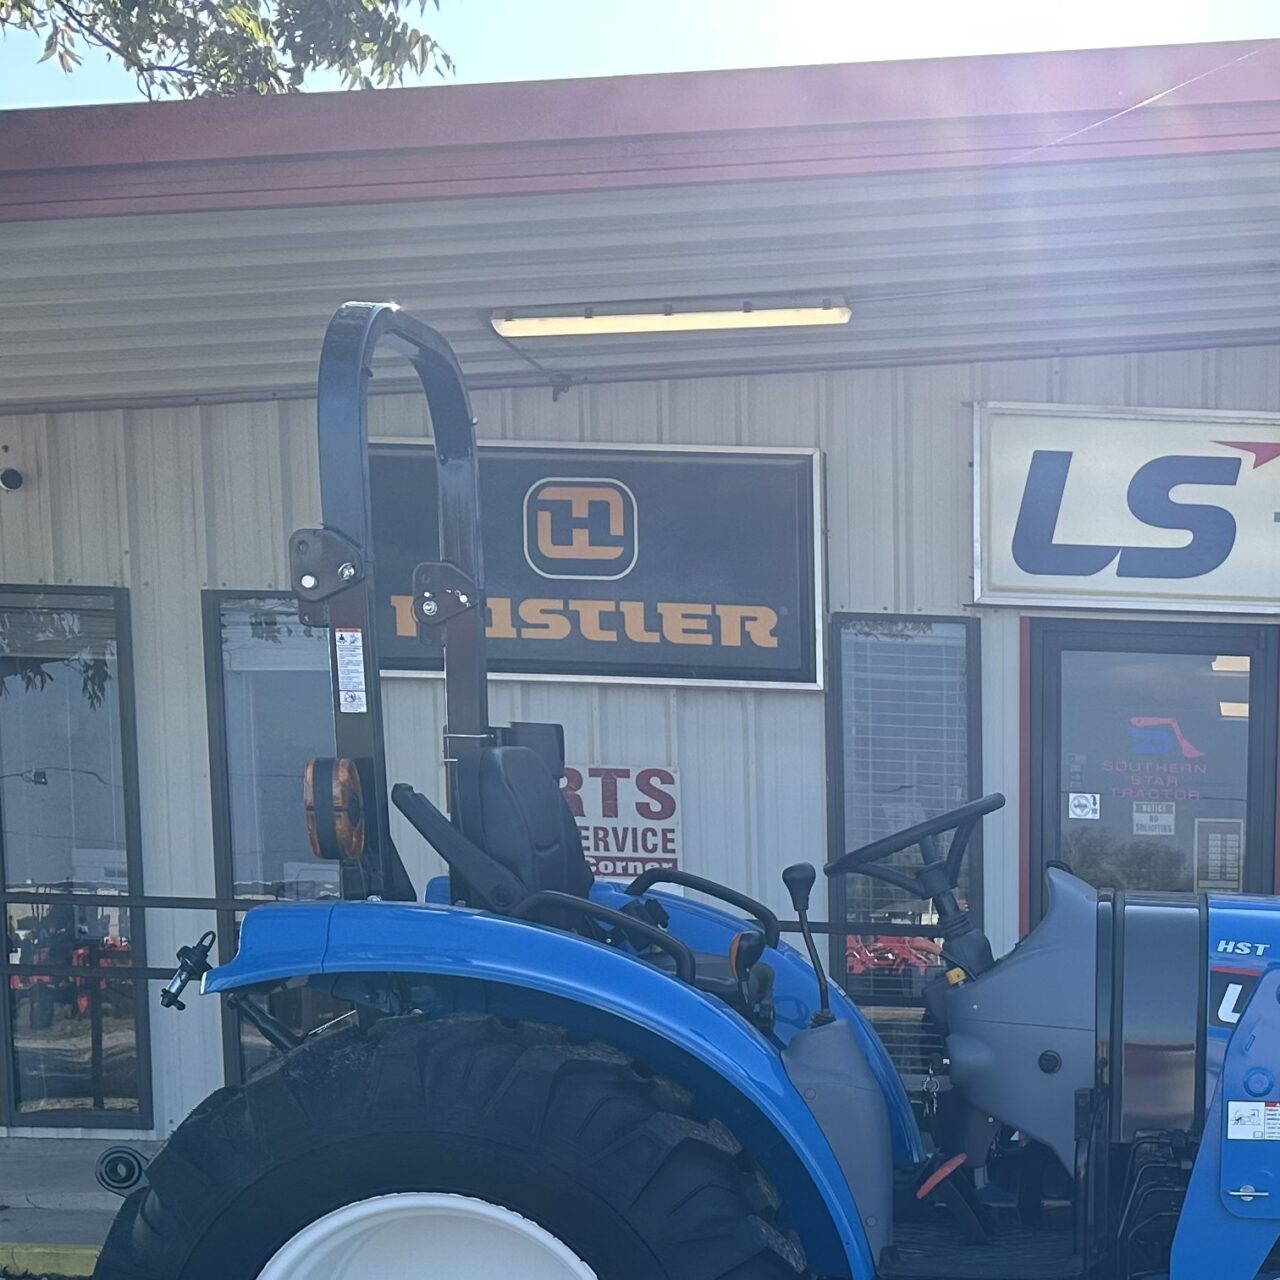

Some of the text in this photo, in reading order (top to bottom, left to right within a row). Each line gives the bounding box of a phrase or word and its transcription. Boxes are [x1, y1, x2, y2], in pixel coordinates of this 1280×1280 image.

[1011, 449, 1243, 579] LS
[1103, 760, 1207, 774] SOUTHERN
[1131, 775, 1178, 786] STAR
[560, 767, 677, 821] RTS
[1111, 787, 1200, 800] TRACTOR
[578, 825, 676, 854] ERVICE
[1217, 939, 1270, 956] HST
[1217, 983, 1243, 1024] L
